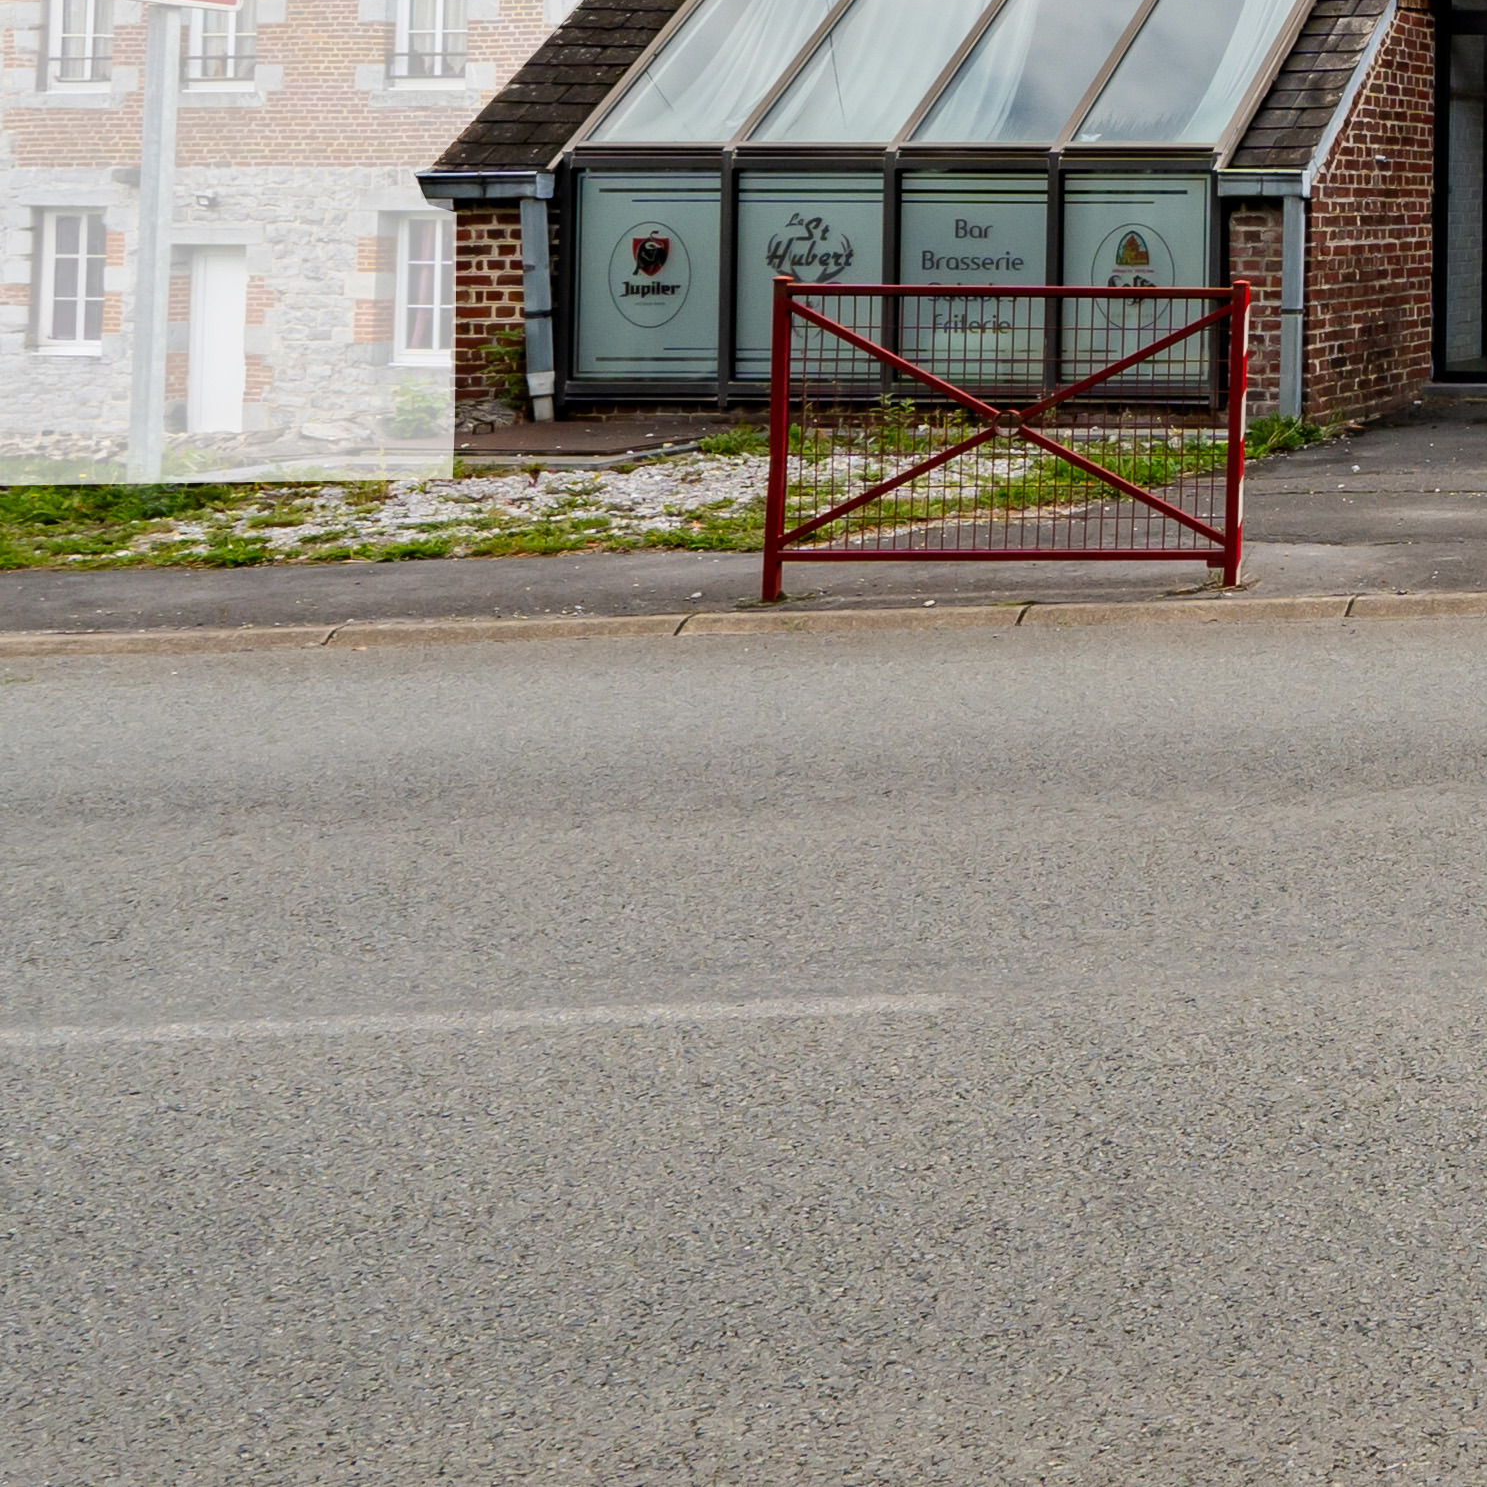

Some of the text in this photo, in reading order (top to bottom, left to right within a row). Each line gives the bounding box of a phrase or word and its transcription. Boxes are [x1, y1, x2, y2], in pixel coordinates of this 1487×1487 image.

[784, 213, 804, 228] Le
[795, 217, 830, 241] St
[955, 218, 993, 239] Bar
[766, 237, 854, 269] Hubert
[922, 250, 1024, 271] Brasserie
[619, 281, 682, 298] Jupiler
